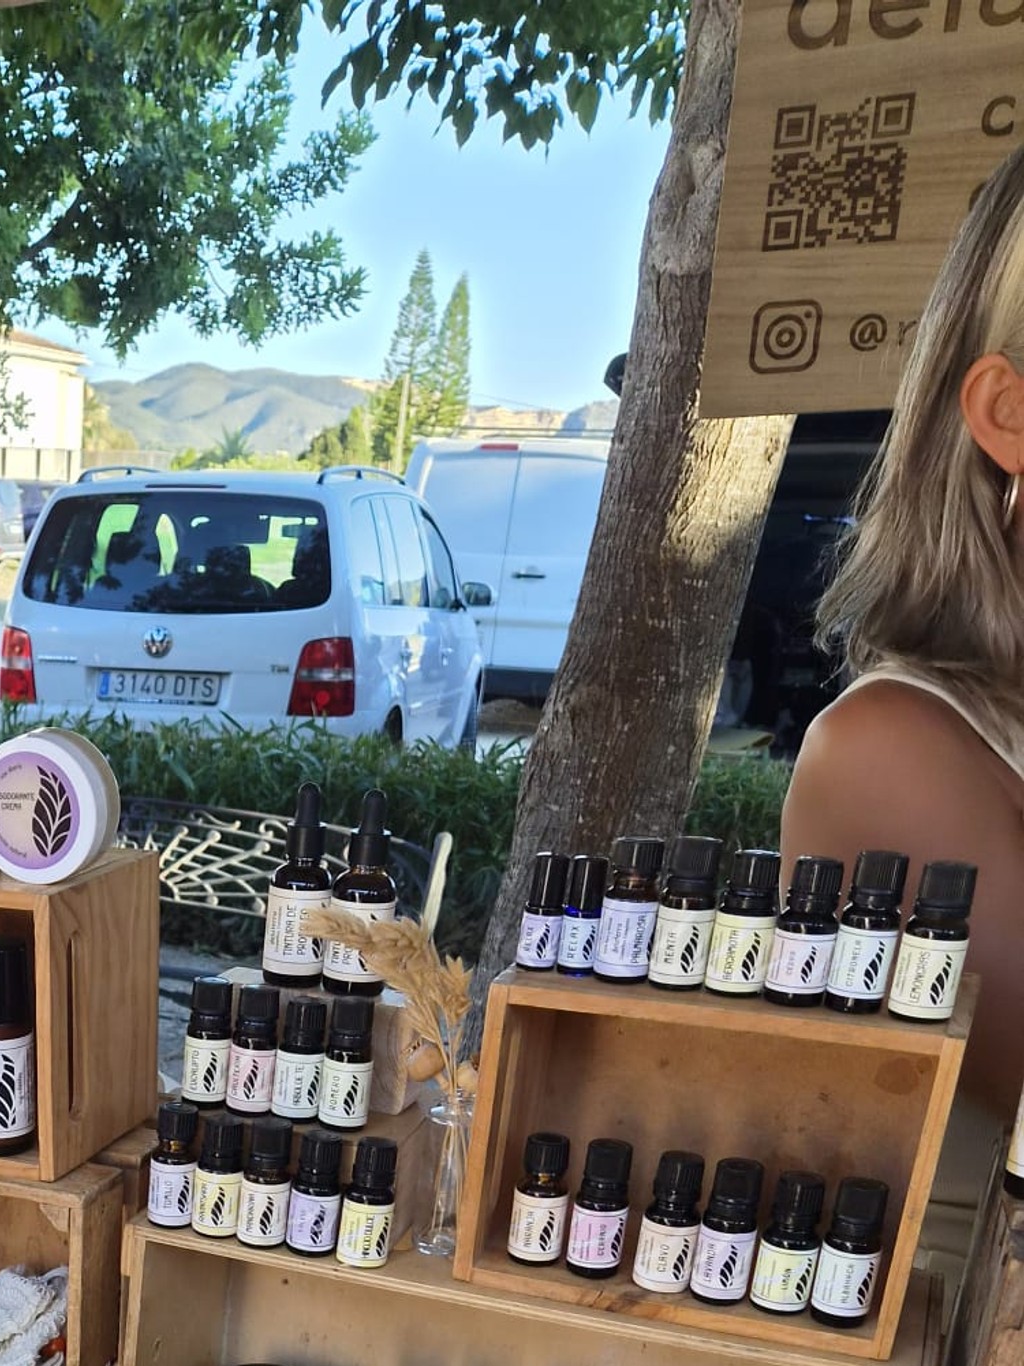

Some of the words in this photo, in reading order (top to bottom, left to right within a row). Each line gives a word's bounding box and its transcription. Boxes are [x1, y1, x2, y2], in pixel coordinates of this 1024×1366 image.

[114, 673, 166, 695] 3140
[173, 676, 213, 698] DTS
[287, 905, 297, 918] DE
[283, 920, 294, 955] TINTURA
[567, 926, 580, 958] RELAX
[632, 915, 647, 963] PALMAROSA
[664, 932, 676, 964] MENTA
[328, 1075, 341, 1110] ROMERO
[656, 1243, 670, 1273] CLAVO
